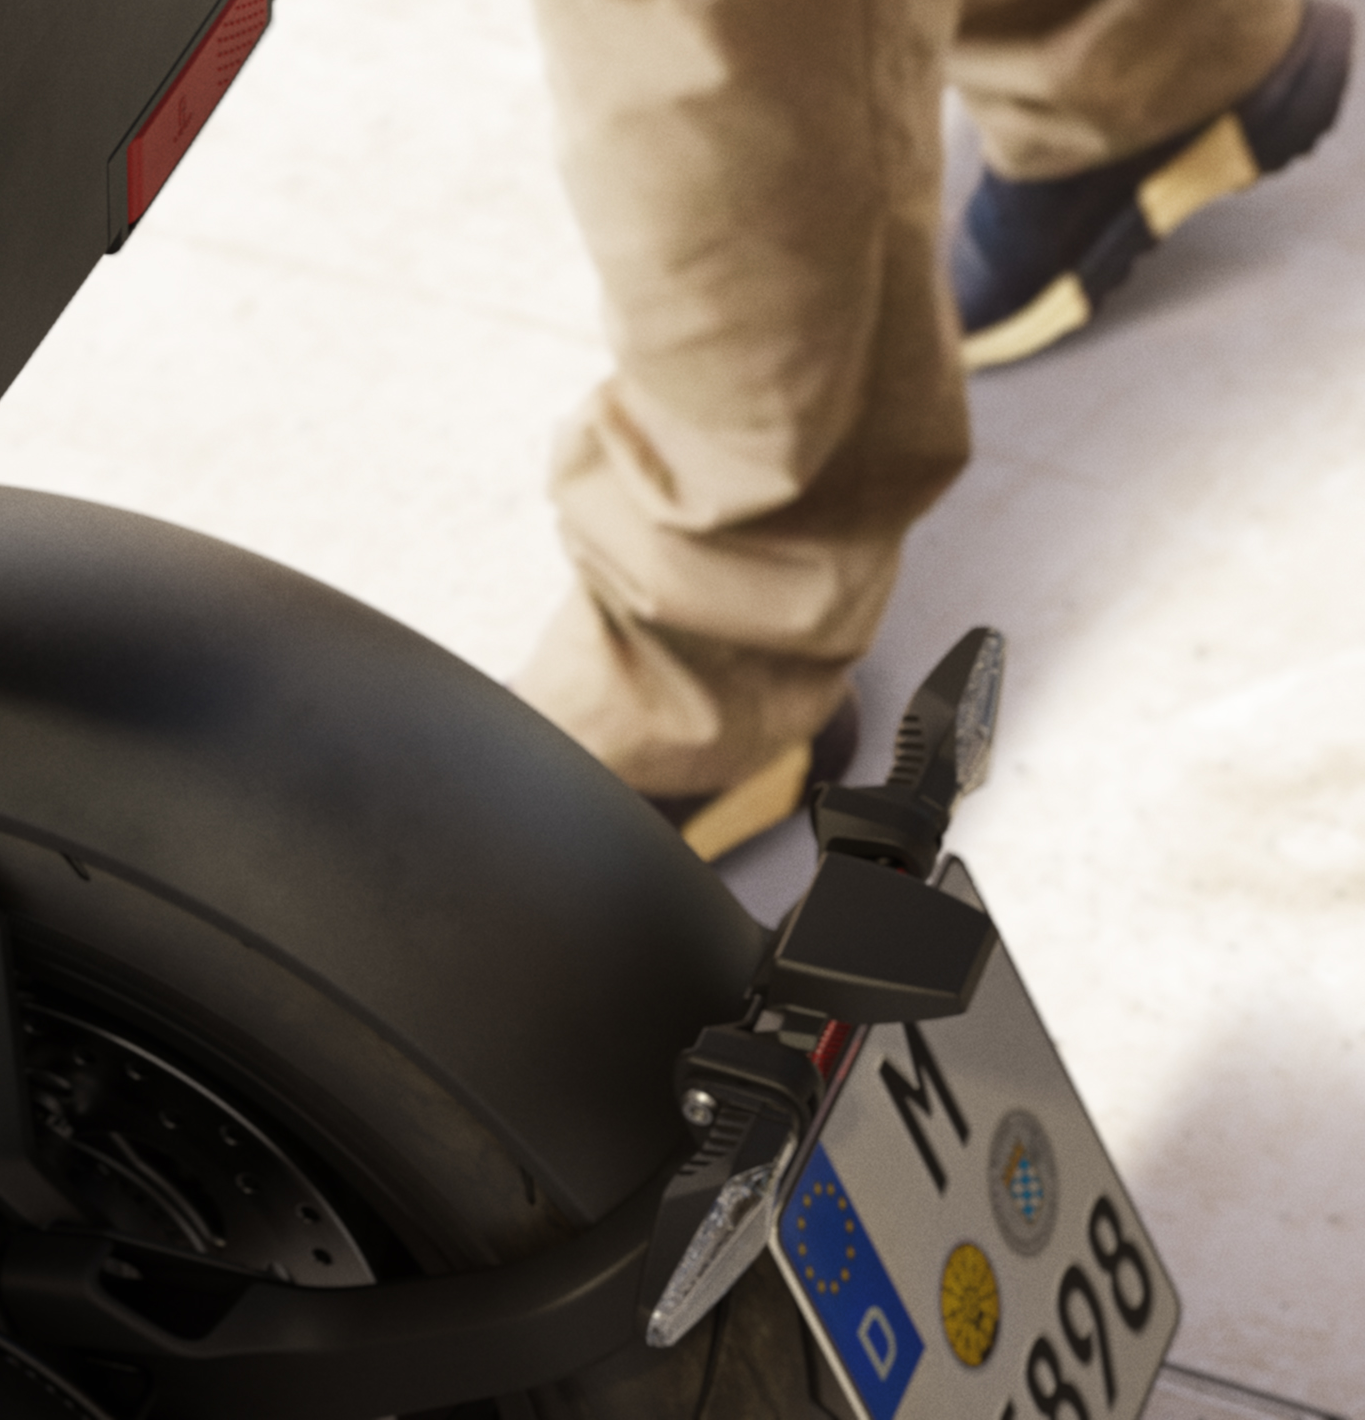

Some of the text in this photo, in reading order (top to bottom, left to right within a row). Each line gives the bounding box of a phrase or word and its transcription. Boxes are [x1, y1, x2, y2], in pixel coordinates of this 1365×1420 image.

[878, 1021, 969, 1195] M
[856, 1304, 898, 1382] D
[1000, 1194, 1153, 1420] 898
